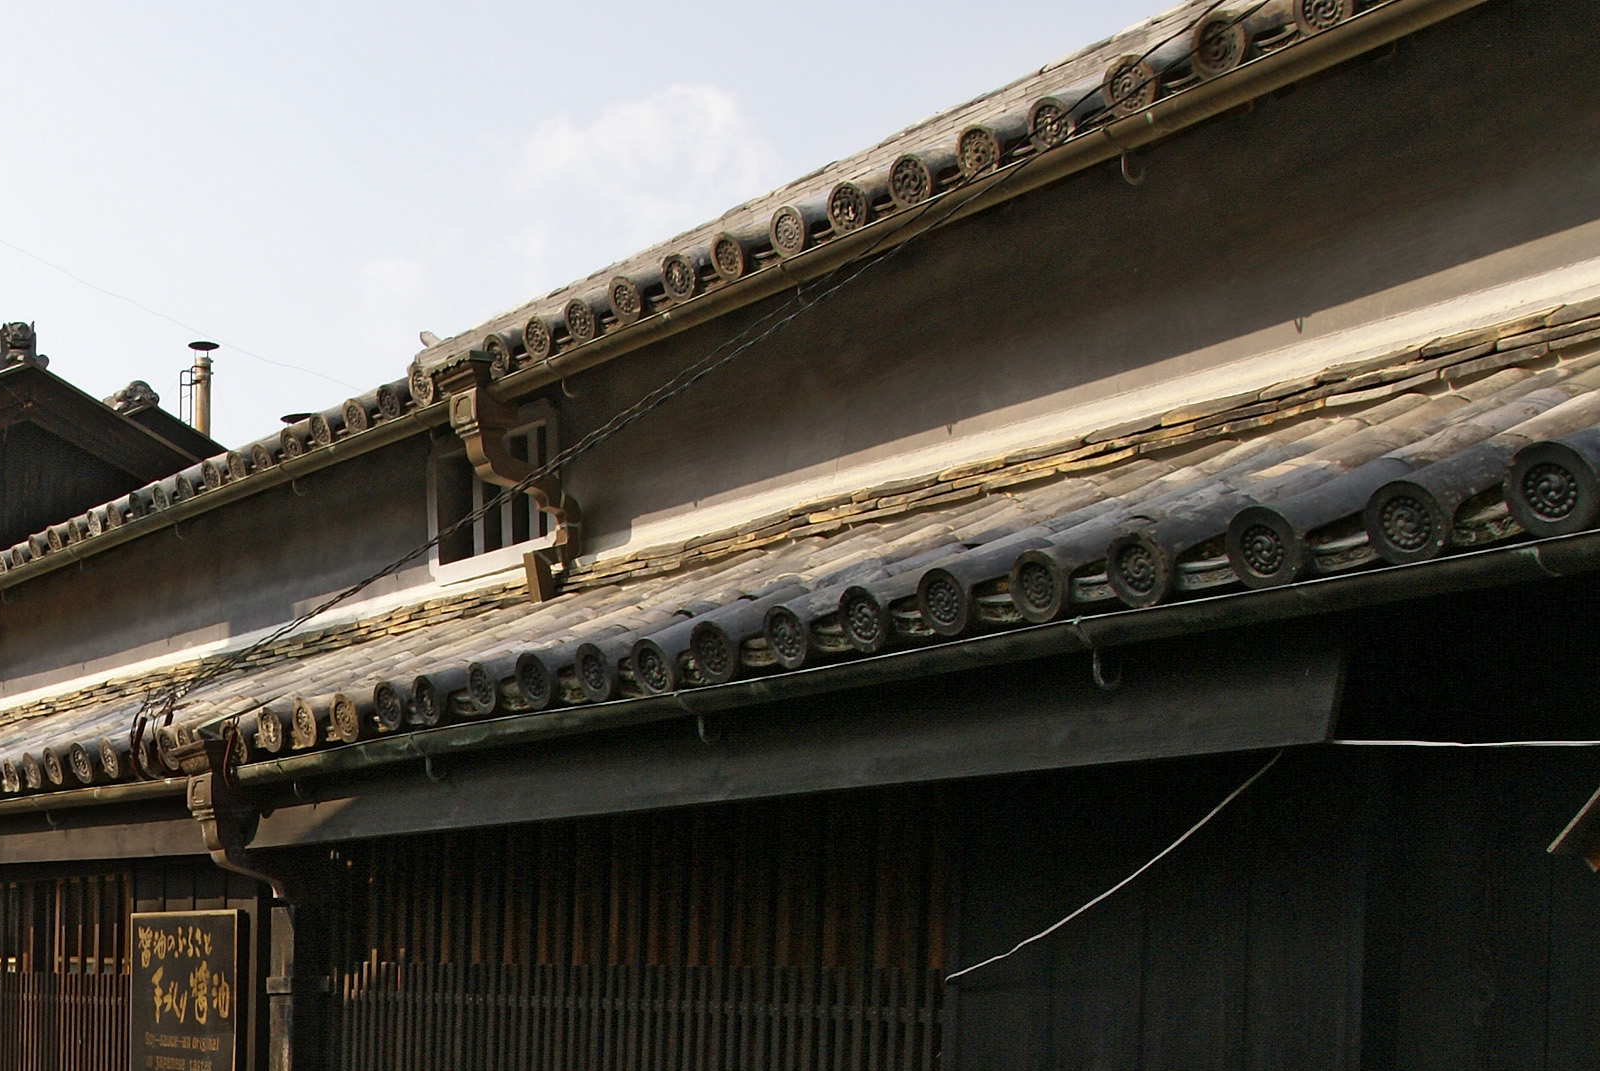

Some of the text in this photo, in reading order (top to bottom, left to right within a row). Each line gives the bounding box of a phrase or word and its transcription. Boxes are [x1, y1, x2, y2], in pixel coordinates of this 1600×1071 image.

[138, 926, 212, 968] 醤油のふるさと
